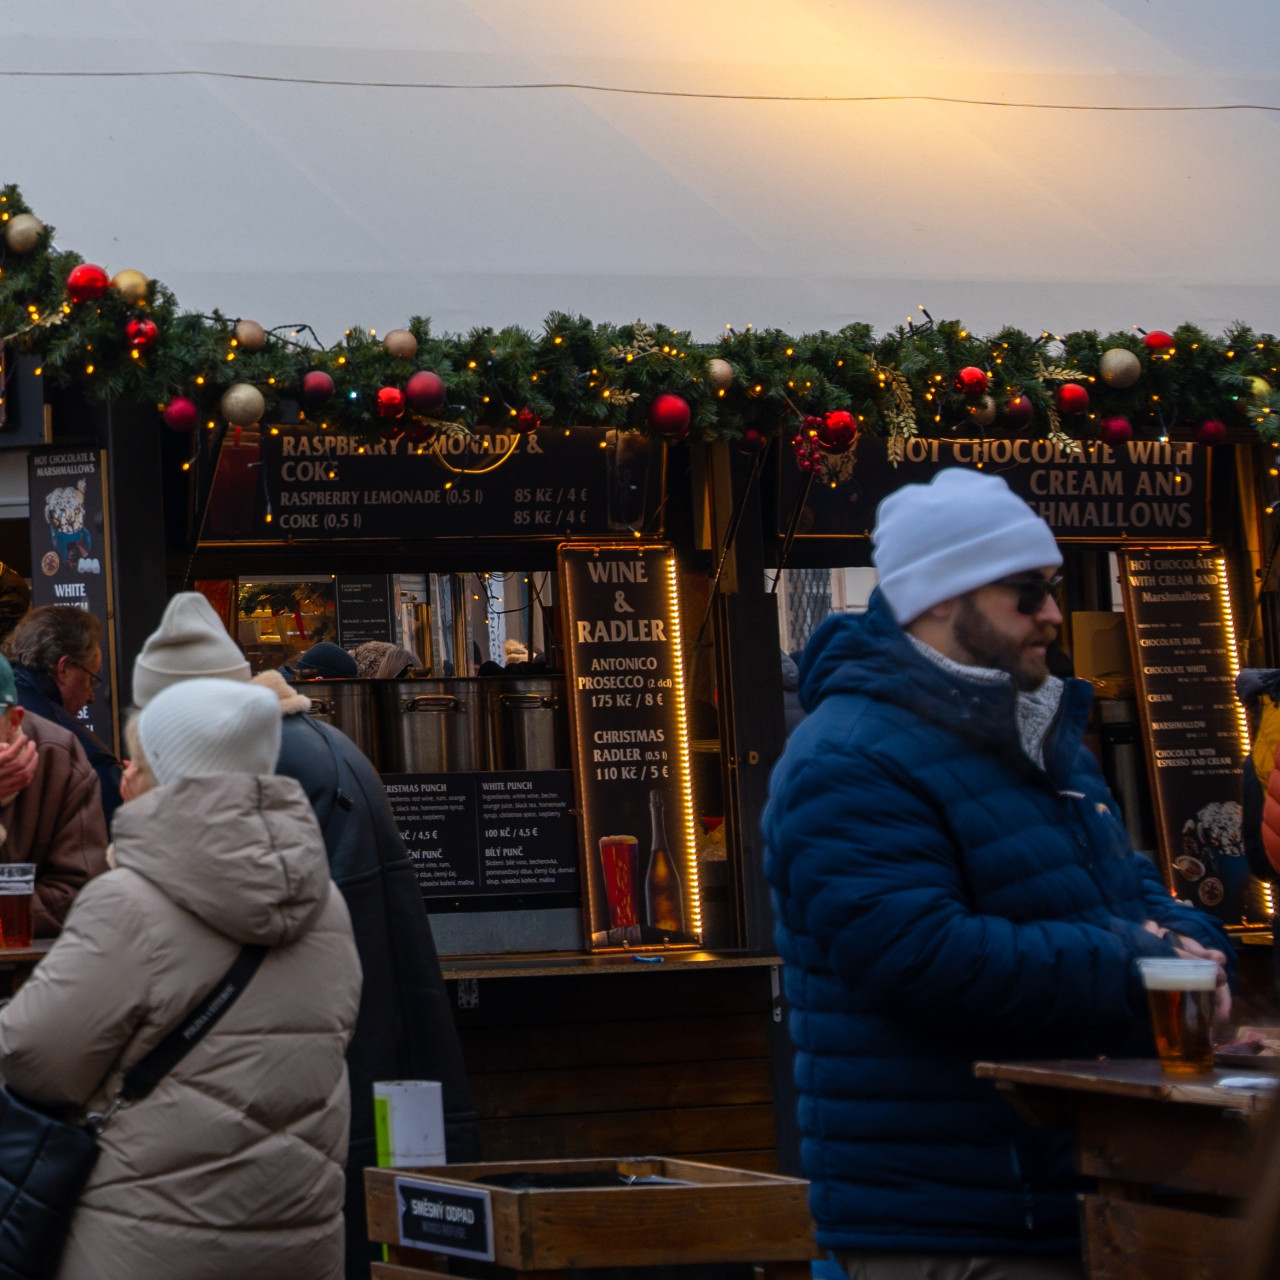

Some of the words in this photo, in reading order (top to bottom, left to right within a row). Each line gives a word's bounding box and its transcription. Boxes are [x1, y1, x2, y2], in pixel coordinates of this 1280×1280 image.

[282, 434, 398, 457] RASPBERRY
[527, 434, 544, 455] &
[952, 437, 1117, 464] CHOCOLATE
[1127, 440, 1194, 465] WITH
[34, 456, 48, 466] HOT
[49, 452, 89, 464] CHOCOLATE
[89, 452, 96, 462] &
[36, 463, 95, 477] MARSHMALLOWS
[281, 460, 340, 482] COKE
[1029, 470, 1125, 496] CREAM
[1135, 471, 1193, 497] AND
[280, 489, 362, 508] RASPBERRY
[363, 488, 442, 505] LEMONADE
[446, 487, 470, 507] (0,5
[514, 487, 532, 504] 85
[535, 487, 553, 503] Kč
[555, 487, 563, 504] /
[567, 487, 576, 502] 4
[580, 486, 589, 501] €
[280, 513, 319, 529] COKE
[324, 513, 349, 530] (0,5
[513, 510, 531, 525] 85
[534, 509, 553, 524] Kč
[555, 509, 563, 525] /
[566, 509, 575, 523] 4
[578, 509, 587, 523] €
[1130, 559, 1151, 571] HOT
[1154, 558, 1215, 570] CHOCOLATE
[587, 561, 649, 584] WINE
[1128, 575, 1156, 587] WITH
[1158, 575, 1194, 586] CREAM
[1196, 574, 1219, 585] AND
[54, 583, 87, 597] WHITE
[1141, 591, 1211, 603] Marshmallows
[614, 590, 636, 613] &
[577, 619, 667, 643] RADLER
[1140, 638, 1182, 647] CHOCOLATE
[1183, 637, 1202, 645] DARK
[591, 657, 658, 671] ANTONICO
[1144, 666, 1185, 675] CHOCOLATE
[1186, 665, 1208, 673] WHITE
[578, 675, 644, 690] PROSECCO
[647, 678, 656, 689] (2
[657, 678, 673, 689] dcl)
[591, 694, 613, 708] 175
[616, 694, 632, 707] Kč
[635, 693, 642, 709] /
[645, 693, 654, 706] 8
[656, 693, 664, 706] €
[1147, 694, 1173, 703] CREAM
[1152, 721, 1206, 731] MARSHMALLOW
[593, 729, 665, 744] CHRISTMAS
[593, 748, 642, 762] RADLER
[645, 751, 660, 761] (0,5
[1155, 749, 1197, 758] CHOCOLATE
[1198, 748, 1216, 757] WITH
[1157, 758, 1189, 768] ESPRESSO
[1191, 758, 1206, 766] AND
[1207, 757, 1232, 766] CREAM
[596, 767, 618, 781] 110
[621, 766, 638, 780] Kč
[640, 766, 647, 781] /
[650, 765, 659, 778] 5
[662, 765, 669, 778] €
[420, 783, 447, 792] PUNCH
[482, 782, 506, 791] WHITE
[507, 781, 533, 791] PUNCH
[418, 831, 431, 841] 4,5
[432, 830, 439, 839] €
[485, 829, 498, 838] 100
[499, 827, 511, 838] KČ
[518, 828, 531, 839] 4,5
[532, 827, 539, 837] €
[422, 848, 444, 859] PUNČ
[485, 846, 501, 857] BÍLÝ
[502, 845, 524, 856] PUNČ
[410, 1197, 444, 1220] SMĚSNÝ
[444, 1205, 476, 1225] ODPAD
